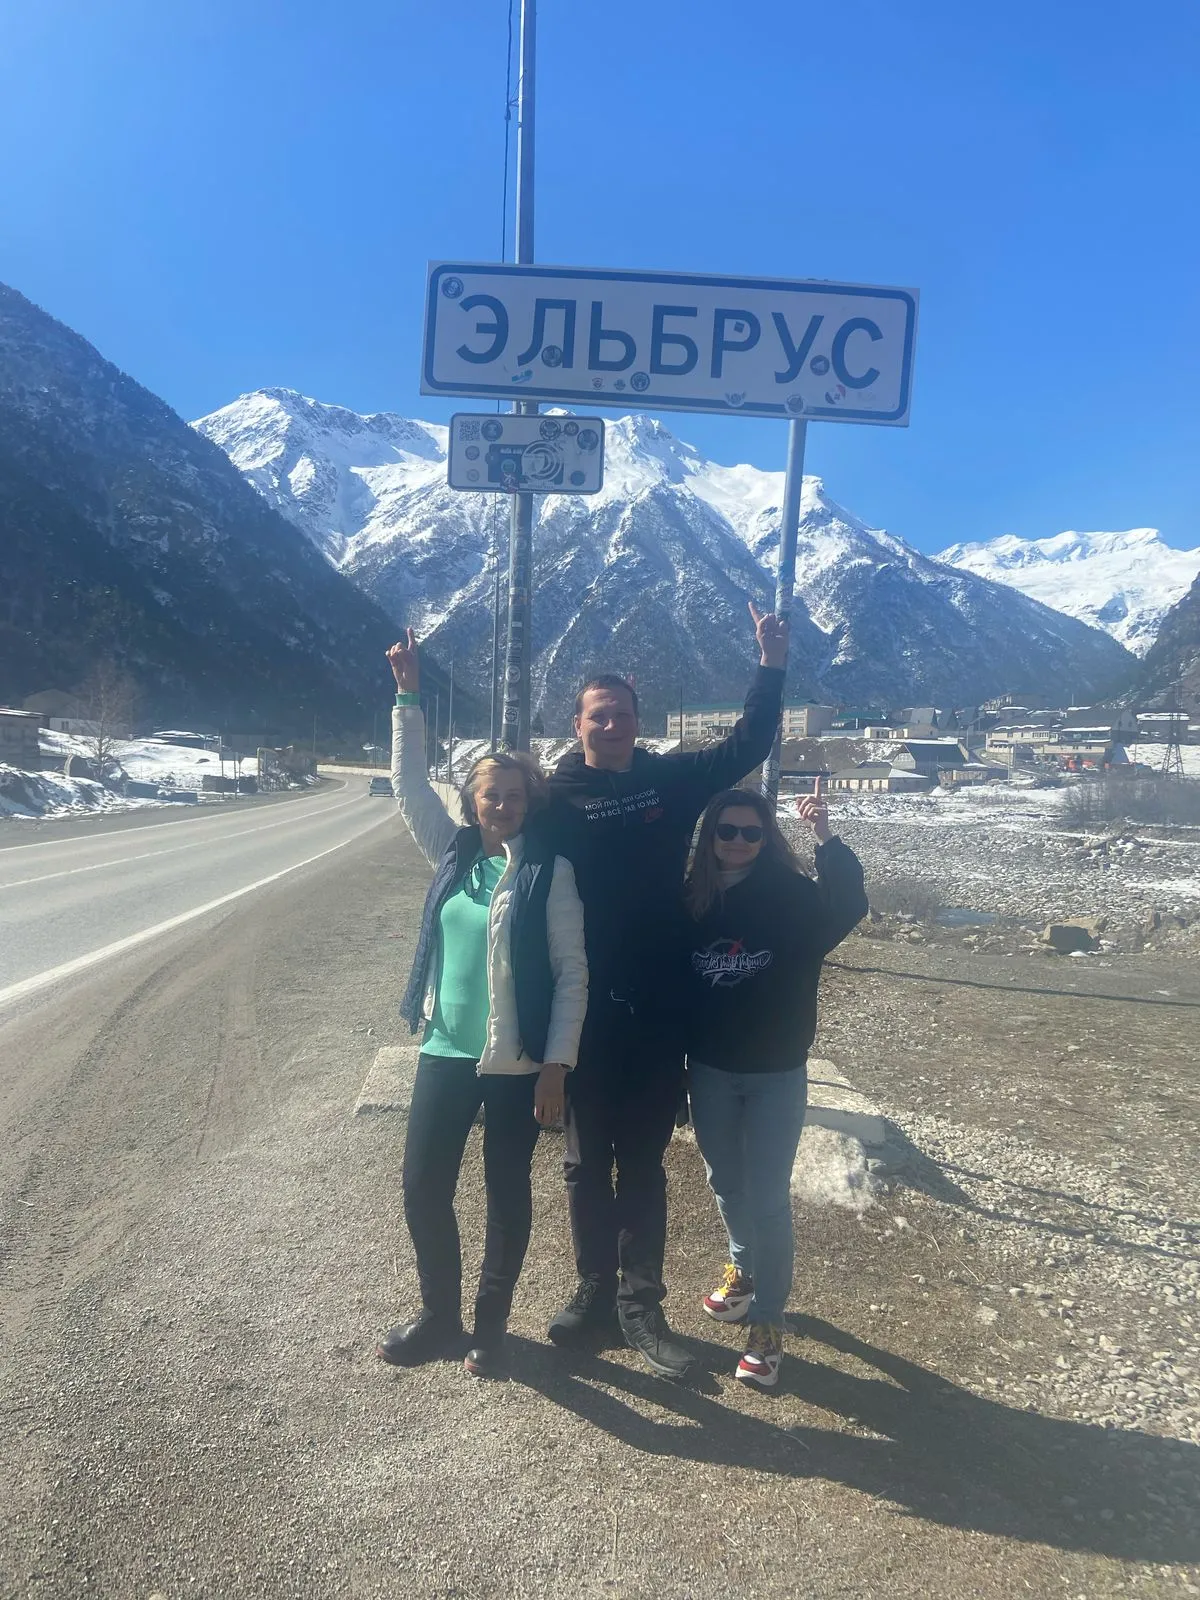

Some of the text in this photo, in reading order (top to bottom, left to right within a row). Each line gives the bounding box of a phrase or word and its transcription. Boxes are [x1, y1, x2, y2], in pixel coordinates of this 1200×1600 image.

[455, 294, 884, 390] ЭЛЬБРУС
[585, 801, 602, 811] МОЙ
[587, 812, 599, 820] НО
